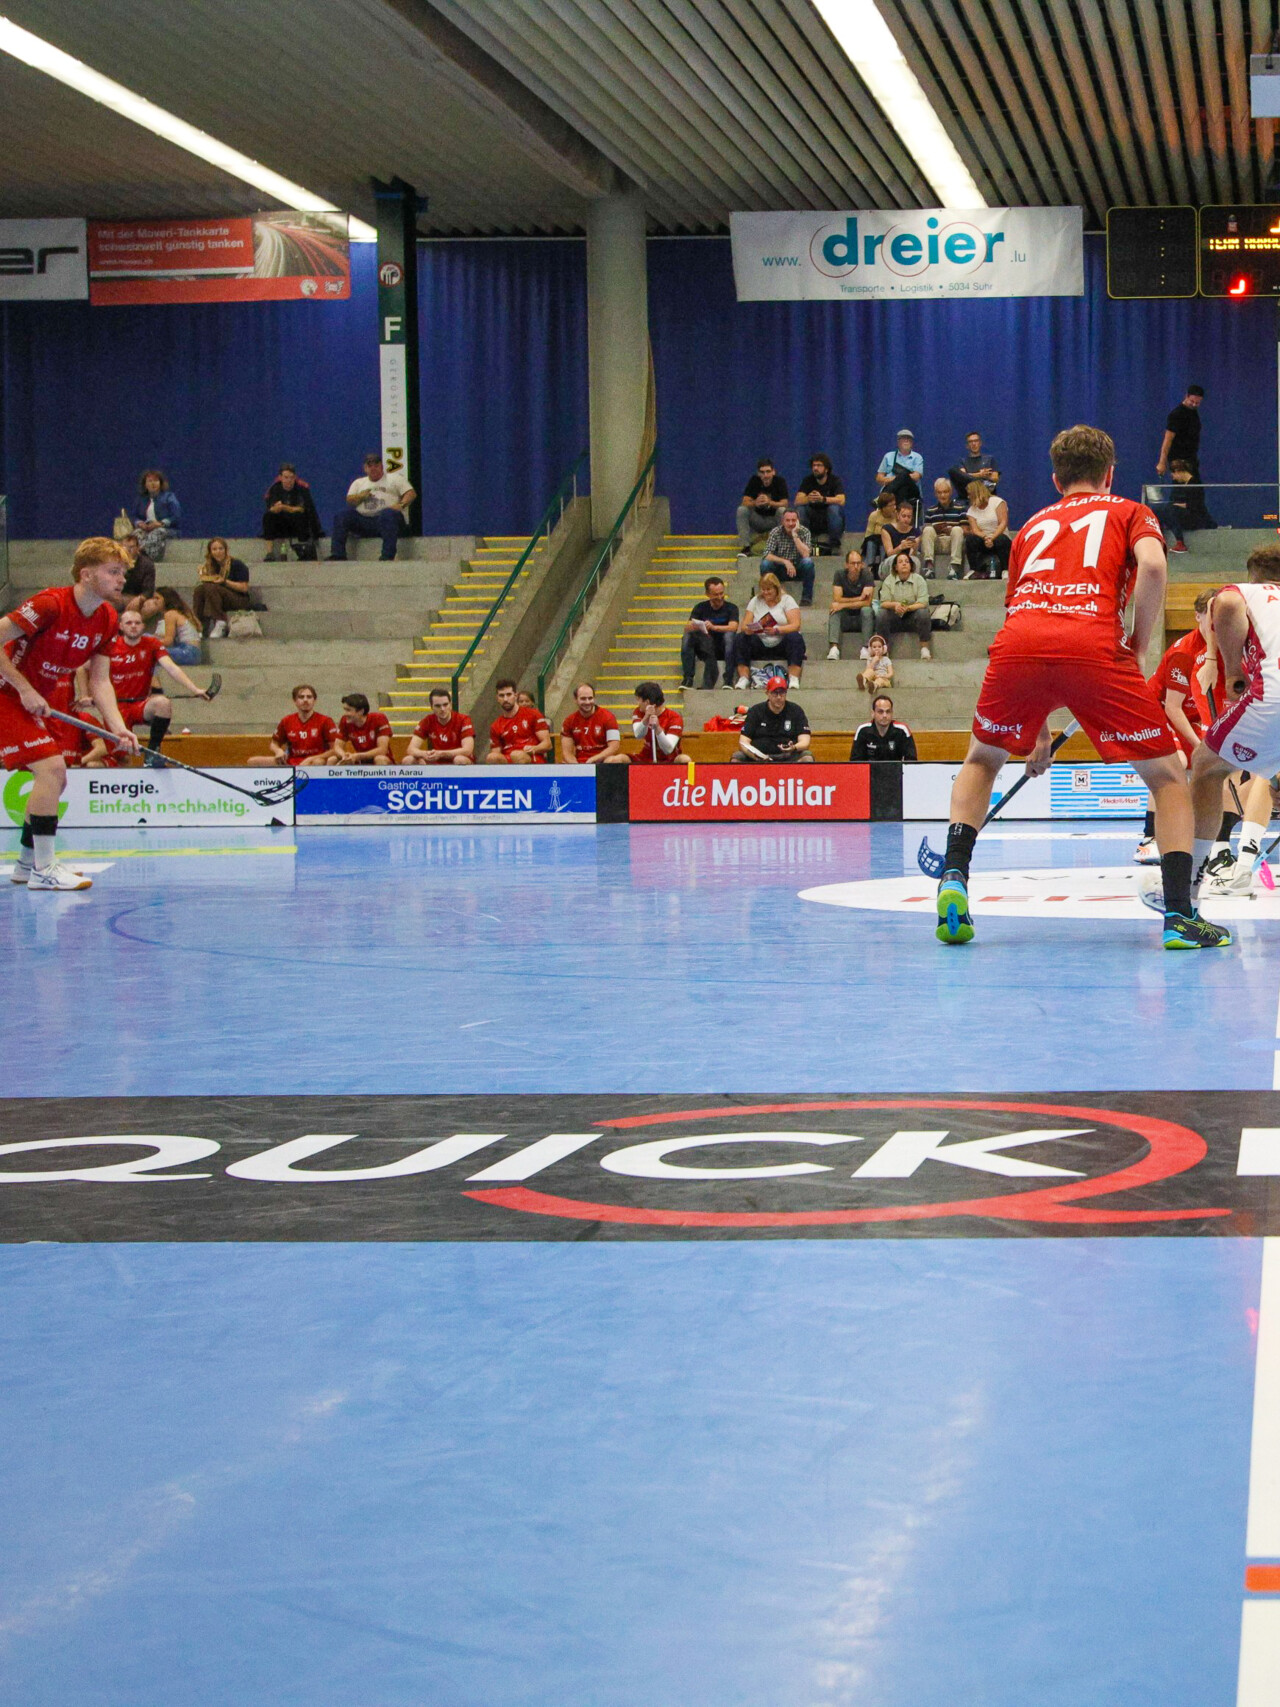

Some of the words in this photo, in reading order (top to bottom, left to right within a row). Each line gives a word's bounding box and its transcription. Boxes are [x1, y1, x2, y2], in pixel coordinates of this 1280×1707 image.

[823, 217, 1004, 266] dreier
[840, 284, 885, 294] Transporte
[900, 283, 934, 294] Logistik
[972, 282, 993, 291] Suhr
[384, 316, 401, 341] F
[1017, 510, 1109, 584] 21
[71, 634, 89, 649] 28
[345, 769, 387, 778] Treffpunkt
[89, 780, 159, 798] Energie.
[254, 779, 281, 787] eniwa
[378, 781, 419, 791] Gasthof
[662, 778, 707, 807] die
[711, 777, 837, 807] Mobiliar
[89, 799, 150, 813] Einfach
[387, 785, 532, 810] SCHÜTZEN
[0, 1130, 1088, 1184] QUICK
